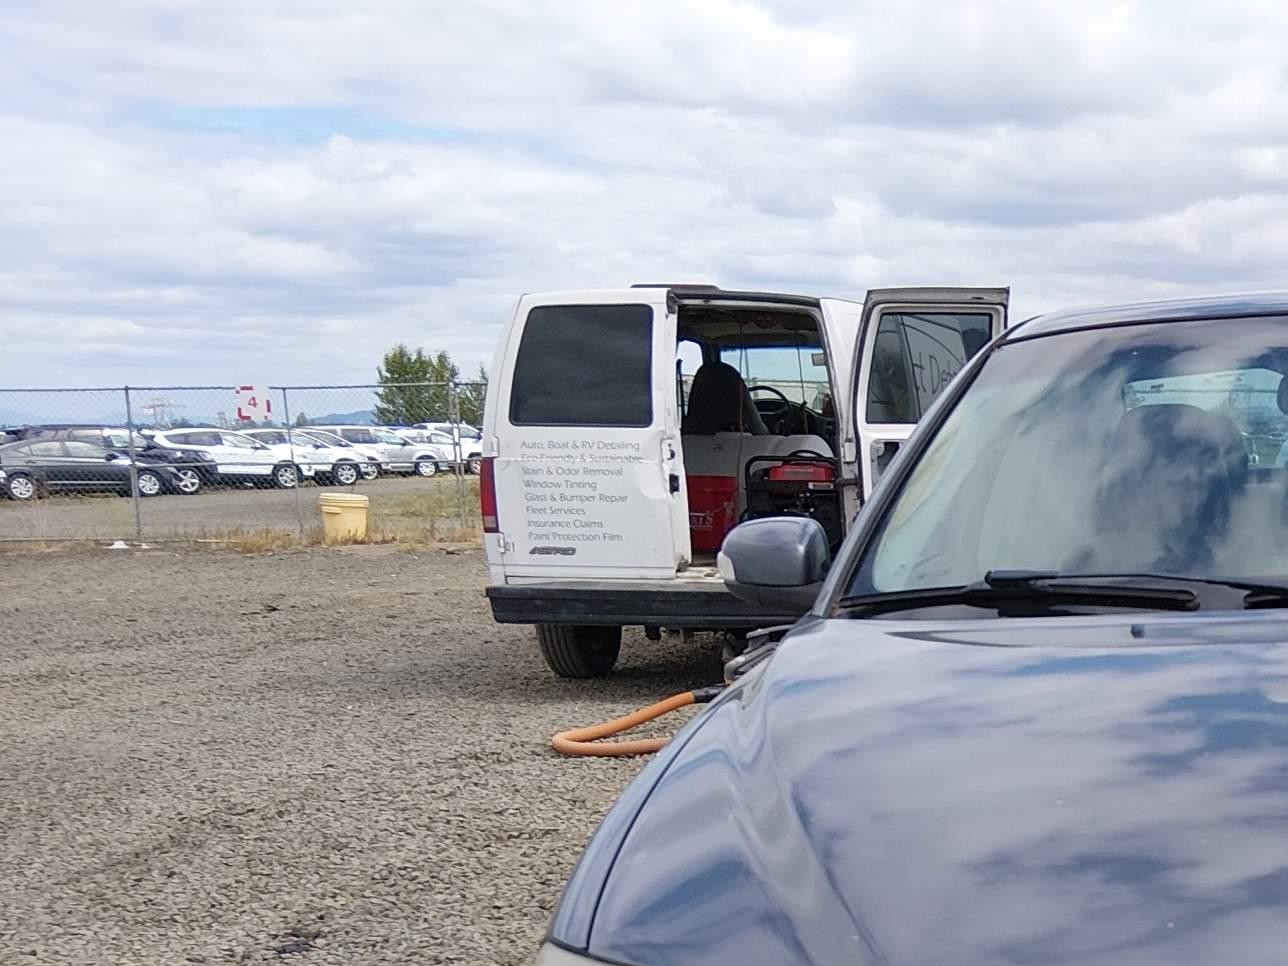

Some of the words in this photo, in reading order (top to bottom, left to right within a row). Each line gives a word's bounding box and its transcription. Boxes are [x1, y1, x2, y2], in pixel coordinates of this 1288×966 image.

[248, 396, 258, 408] 4
[548, 440, 569, 449] Boat
[571, 440, 579, 449] &
[581, 440, 595, 449] RV
[597, 440, 640, 451] Detailing
[521, 466, 544, 476] Stain
[546, 467, 553, 475] &
[555, 467, 580, 476] Odor
[583, 467, 623, 476] Removal
[523, 480, 562, 489] Window
[565, 480, 597, 491] Tinting
[525, 493, 548, 502] Glass
[550, 493, 558, 502] &
[560, 493, 596, 504] Bumper
[599, 494, 628, 504] Repair
[526, 506, 548, 515] Fleet
[550, 506, 586, 515] Services
[527, 519, 571, 528] Insurance
[573, 519, 604, 528] Claims
[528, 532, 551, 541] Paint
[553, 532, 601, 541] Protection
[603, 532, 623, 541] Film
